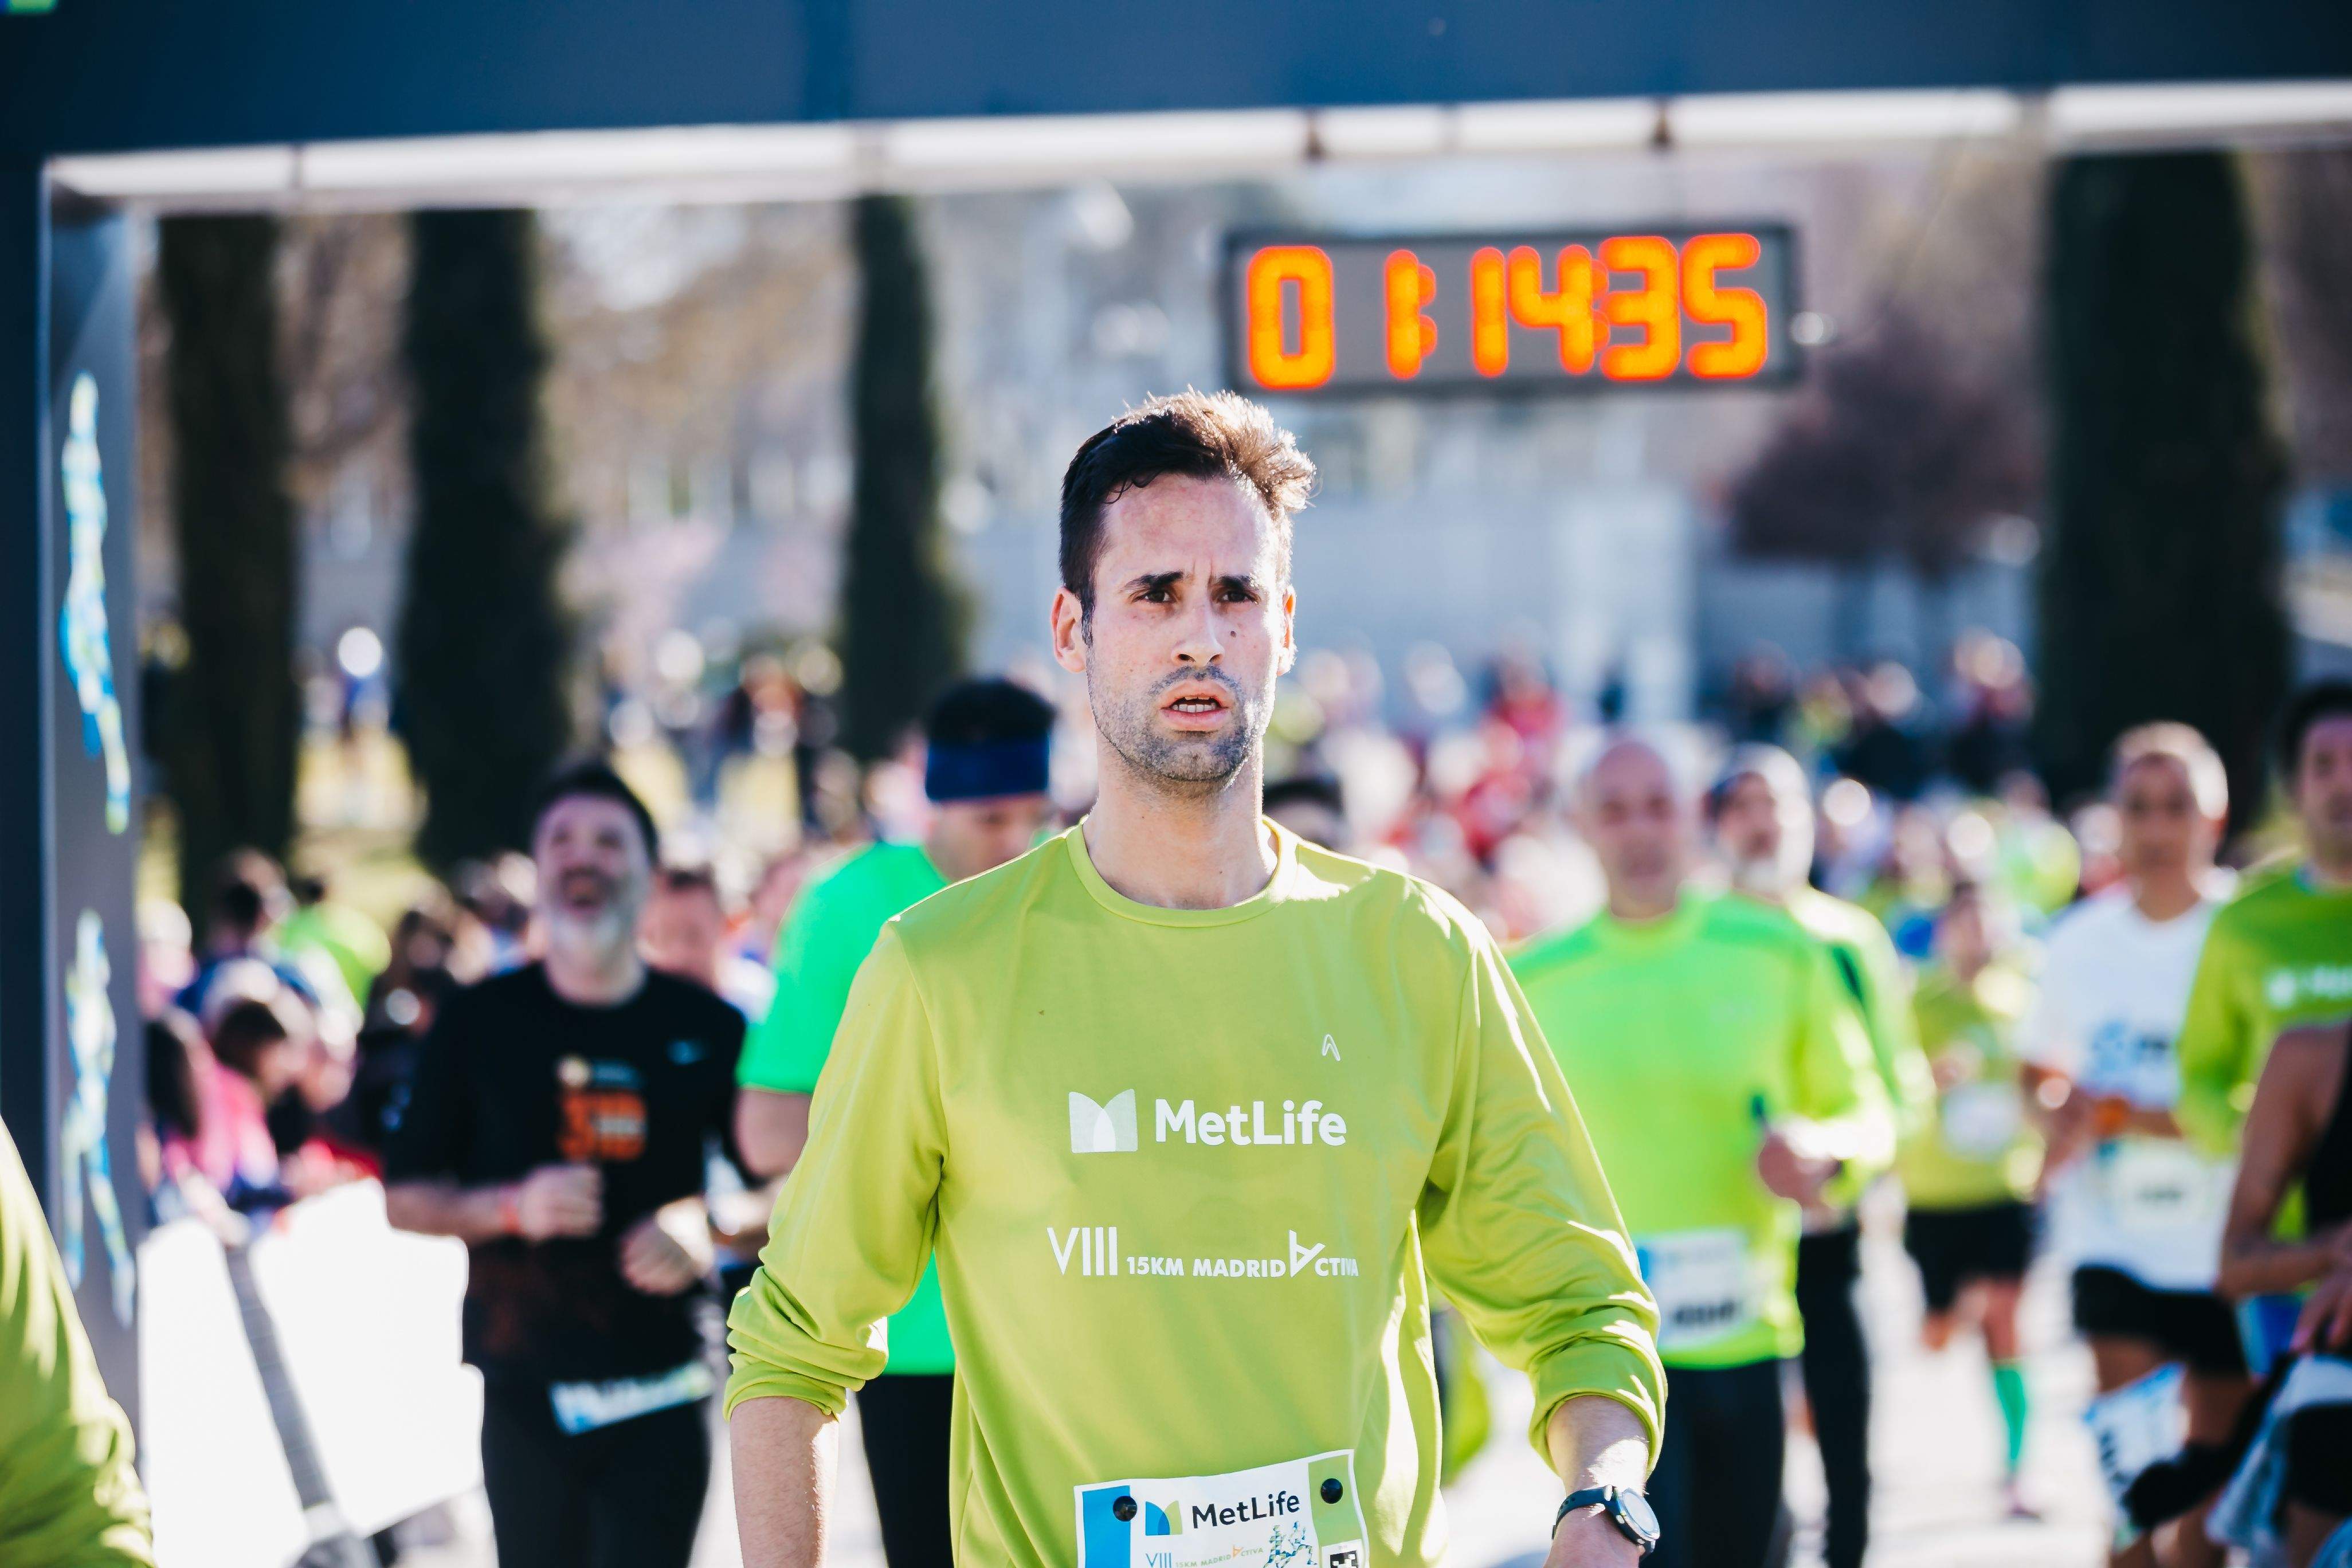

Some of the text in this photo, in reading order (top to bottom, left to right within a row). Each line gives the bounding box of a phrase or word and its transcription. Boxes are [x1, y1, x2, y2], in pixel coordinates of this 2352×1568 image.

[1155, 1099, 1347, 1146] MetLife
[1046, 1226, 1118, 1276] VIII
[1127, 1256, 1185, 1276] 15KM
[1192, 1490, 1300, 1528] MetLife
[1146, 1552, 1172, 1568] VIII
